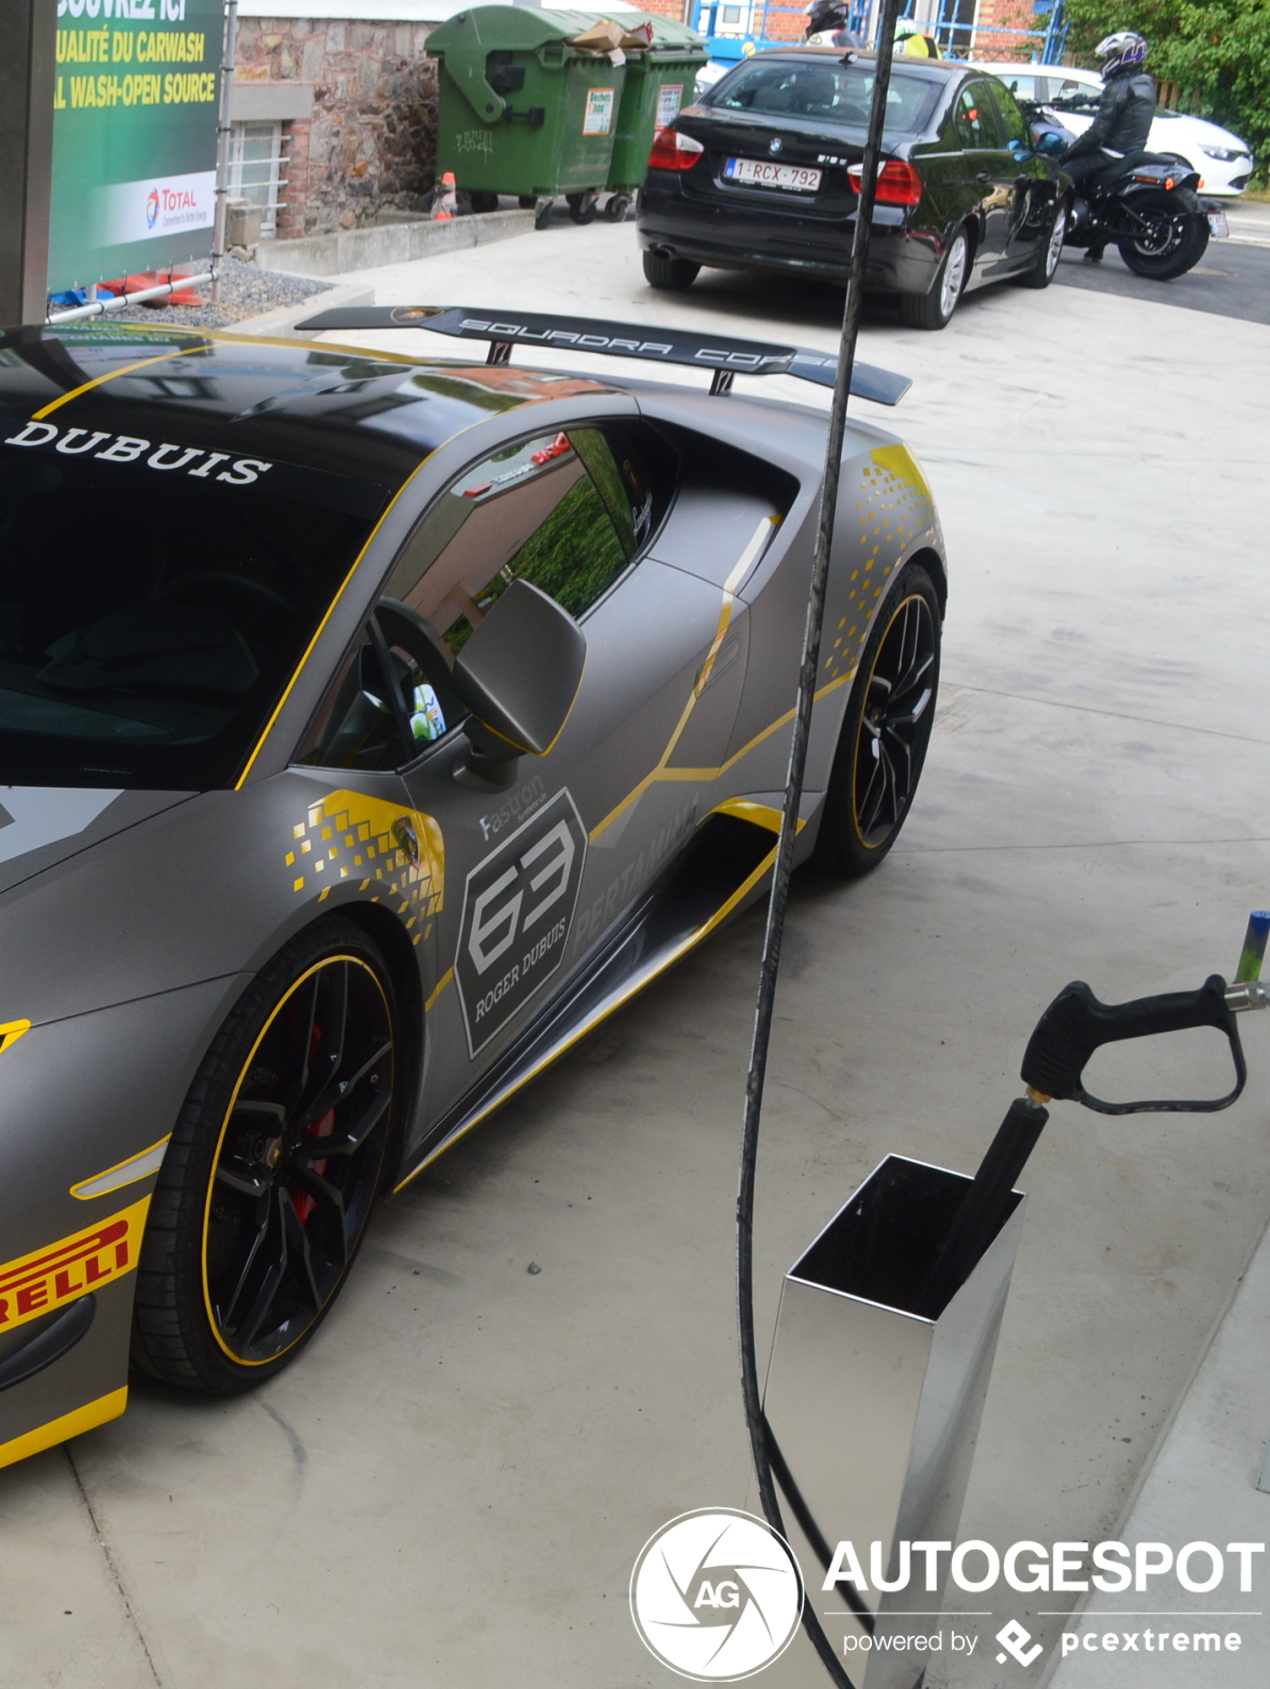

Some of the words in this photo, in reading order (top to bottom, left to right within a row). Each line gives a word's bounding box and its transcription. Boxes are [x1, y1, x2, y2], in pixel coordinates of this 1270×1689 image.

[55, 24, 110, 63] UALITÉ
[112, 31, 134, 63] DU
[136, 31, 205, 63] CARWASH
[70, 74, 161, 108] WASH-OPEN
[163, 72, 216, 104] SOURCE
[162, 189, 197, 211] TOTAL
[458, 318, 673, 355] SQUADRA
[5, 420, 273, 485] DUBUIS
[479, 775, 544, 842] Fastron
[468, 819, 575, 975] 63
[474, 959, 520, 1023] ROGER
[522, 917, 567, 976] DUBUIS
